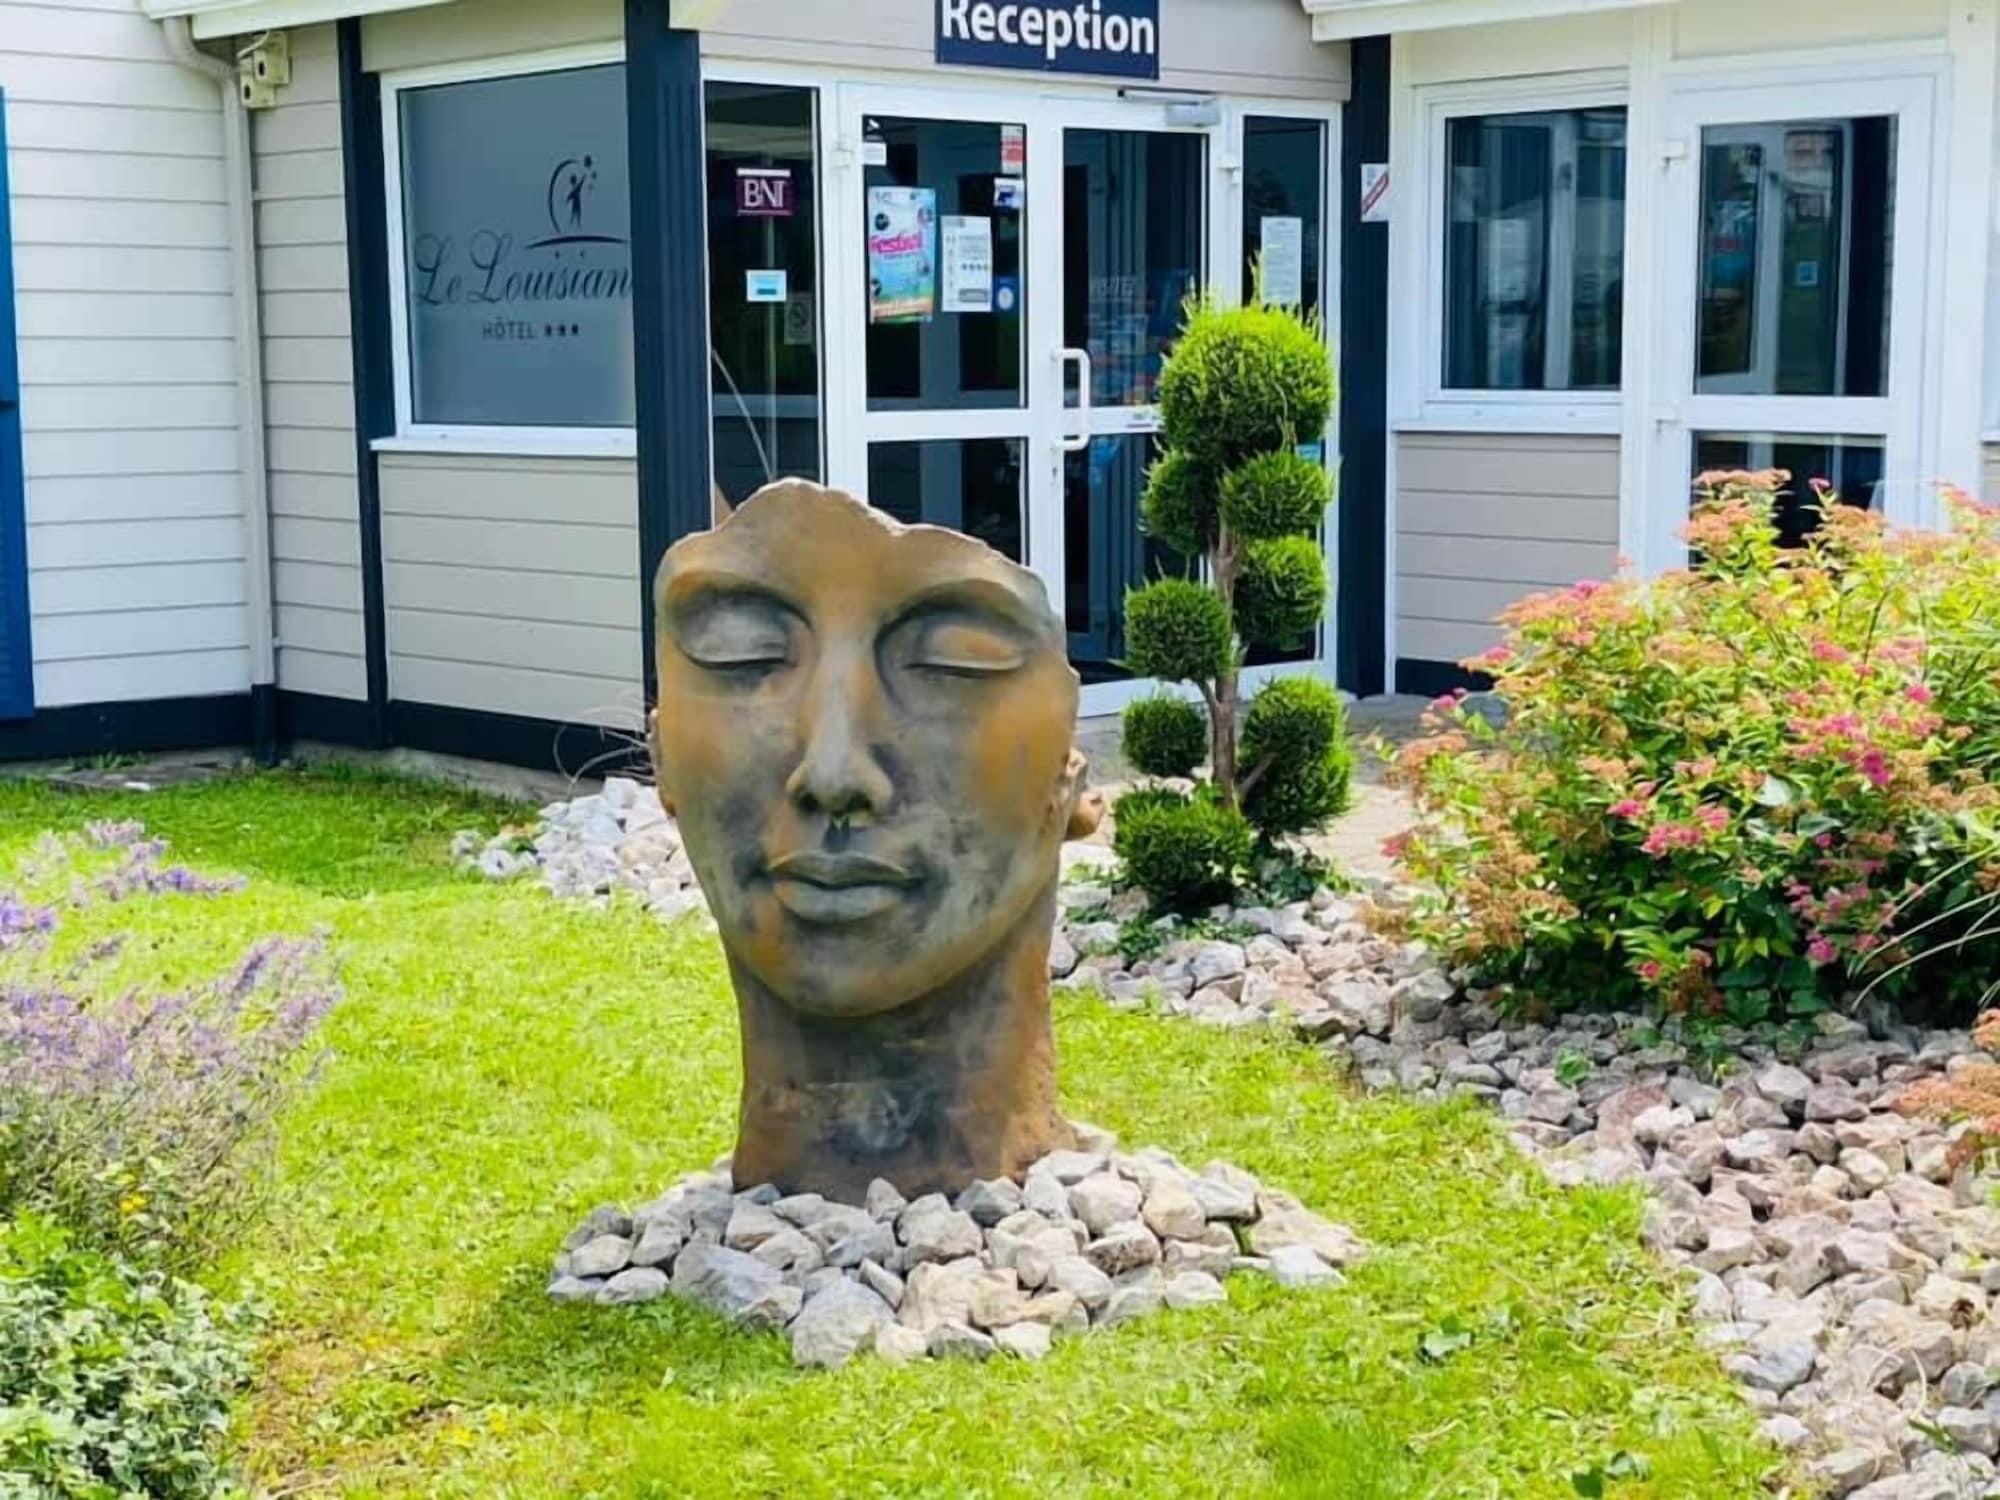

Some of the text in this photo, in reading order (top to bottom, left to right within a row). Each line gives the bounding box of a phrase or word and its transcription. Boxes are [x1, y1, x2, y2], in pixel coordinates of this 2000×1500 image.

[941, 0, 1155, 60] Reception
[414, 232, 462, 305] Le
[482, 315, 536, 340] HÔTEL
